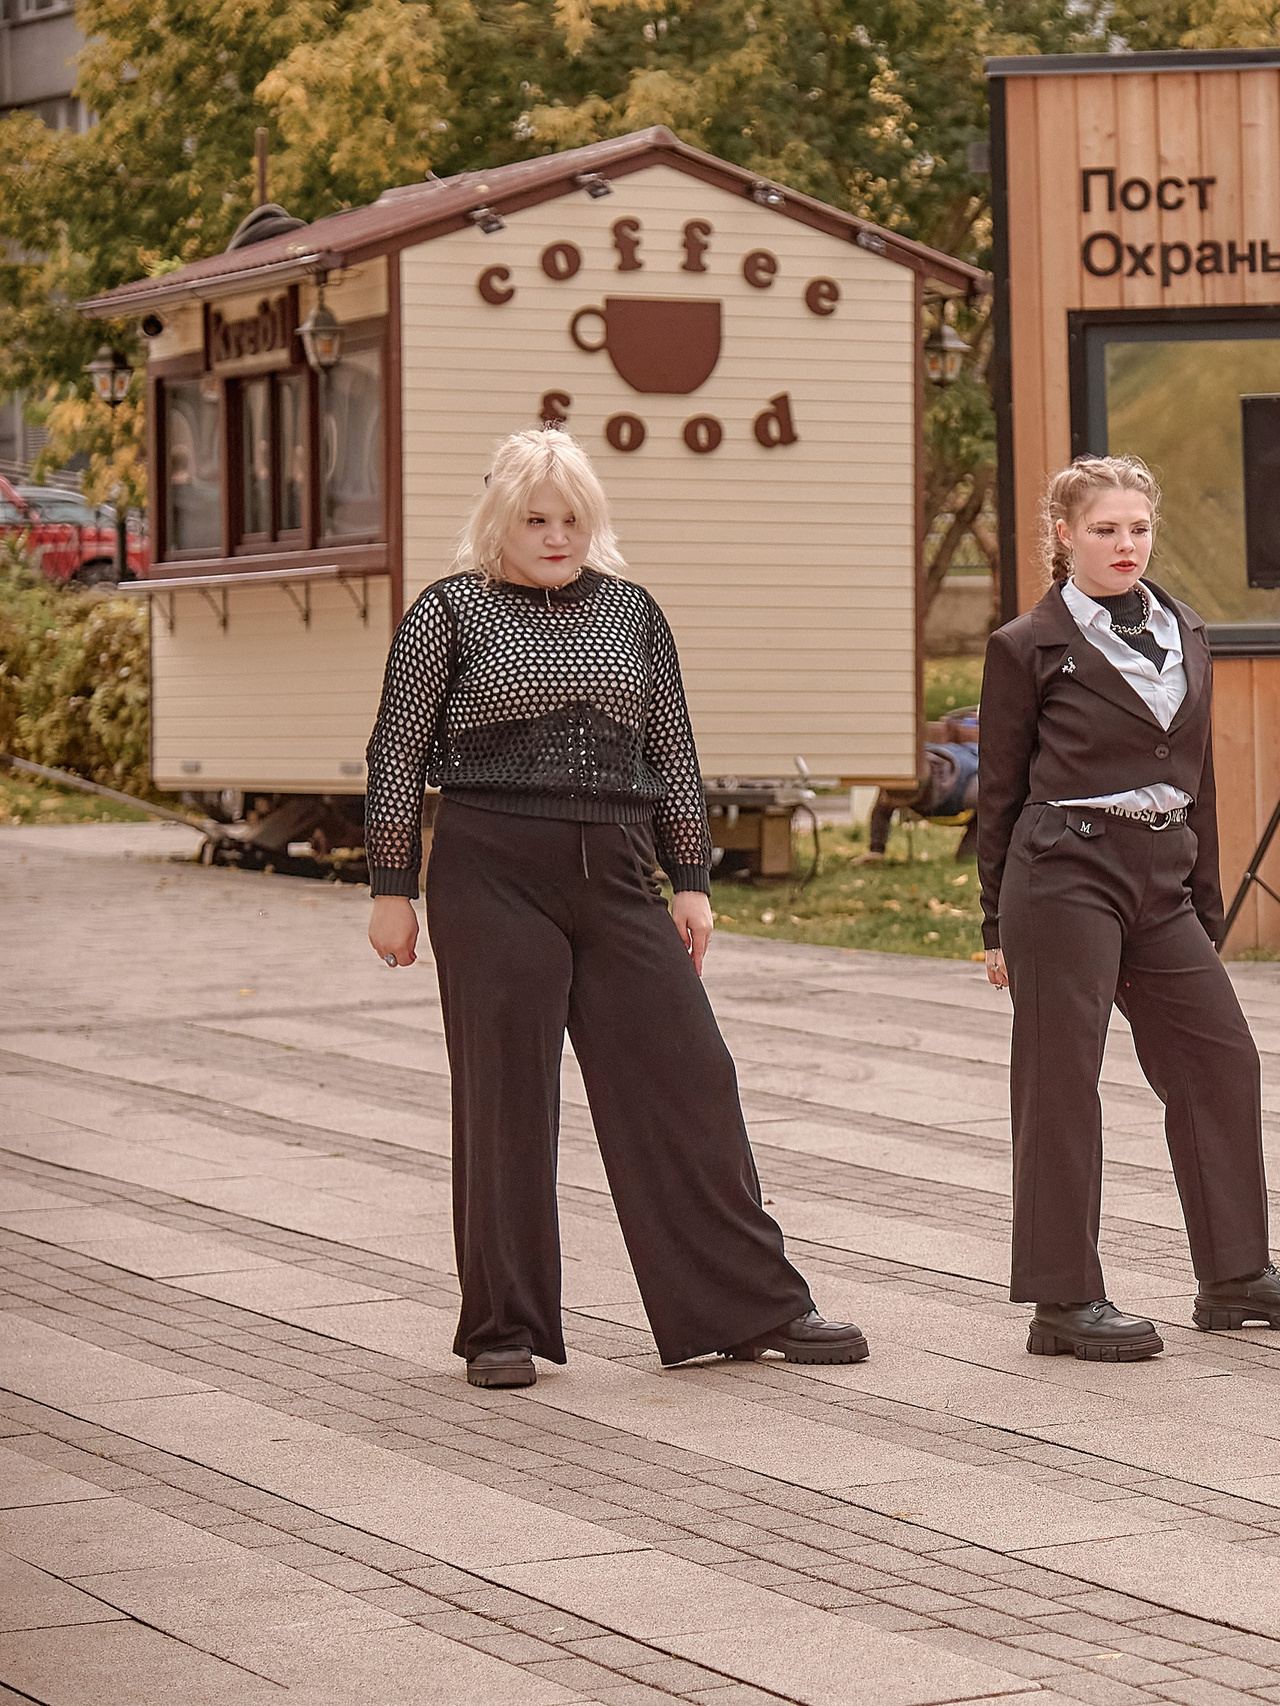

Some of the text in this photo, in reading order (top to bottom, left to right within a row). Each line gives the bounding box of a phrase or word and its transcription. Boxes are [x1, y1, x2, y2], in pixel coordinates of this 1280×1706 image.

[1082, 167, 1216, 212] Пост
[479, 218, 840, 317] coffee
[540, 391, 798, 452] food
